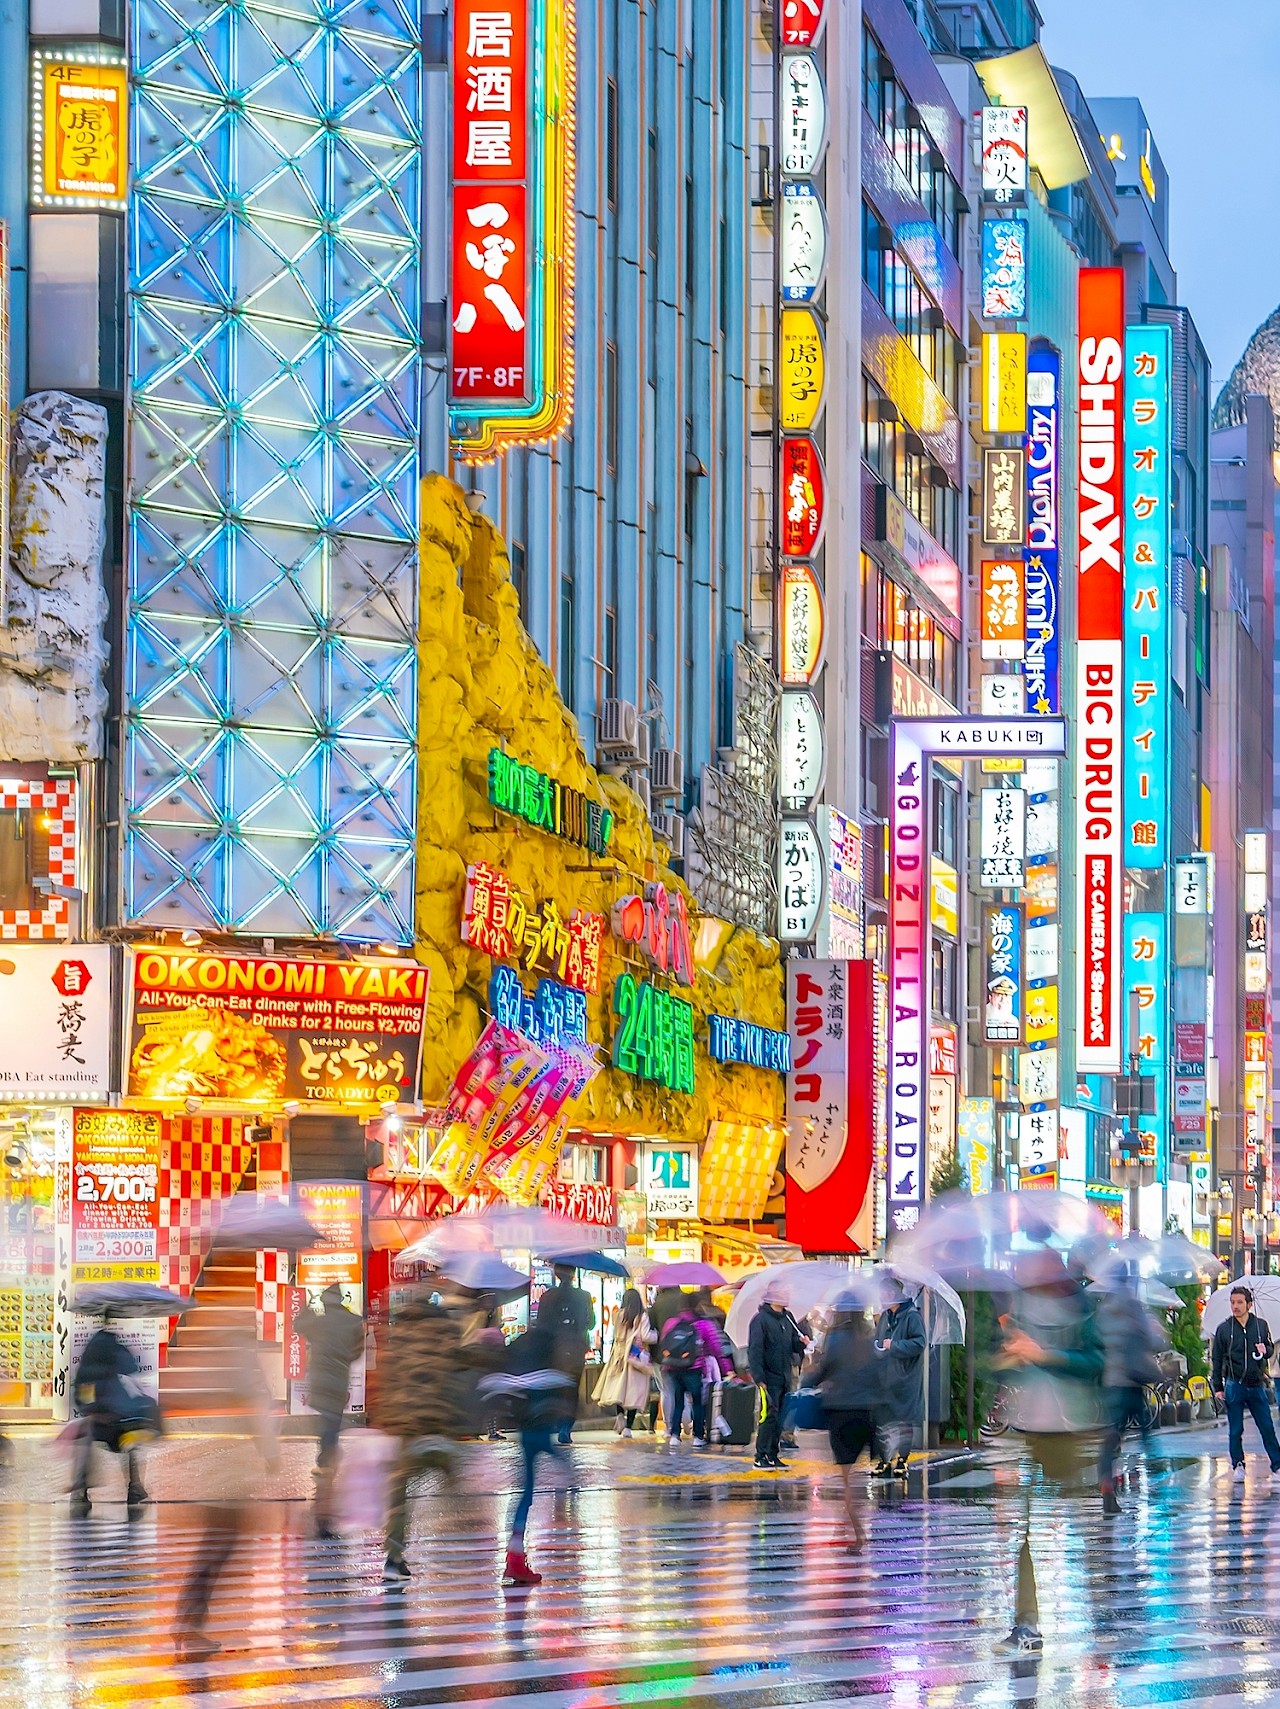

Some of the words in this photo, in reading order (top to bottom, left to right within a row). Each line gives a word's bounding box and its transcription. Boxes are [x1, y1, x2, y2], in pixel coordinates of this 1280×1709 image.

[786, 31, 810, 42] 7F
[50, 67, 82, 81] 4F
[465, 11, 513, 167] 居酒屋
[68, 108, 103, 167] 虎の子
[785, 154, 812, 170] 6F
[994, 189, 1012, 203] 8F
[453, 202, 525, 333] つぼ八
[789, 287, 808, 299] 5F
[787, 344, 818, 401] 虎の子
[786, 413, 805, 424] 4F
[1080, 336, 1122, 574] SHIDAX
[1086, 664, 1113, 725] BIC
[1086, 738, 1113, 840] DRUG
[787, 797, 807, 809] 1F
[785, 830, 809, 842] 新宿
[895, 795, 920, 1023] GODZILLA
[786, 917, 808, 931] B1
[990, 912, 1014, 975] 海の家
[63, 963, 83, 989] 旨
[139, 955, 324, 994] OKONOMI
[340, 965, 426, 998] YAKI
[140, 993, 252, 1010] All-You-Can-Eat
[255, 997, 300, 1012] dinner
[304, 1000, 331, 1014] with
[335, 1002, 421, 1020] Free-Flowing
[826, 964, 845, 1041] 大衆酒場
[56, 1001, 86, 1065] 蕎麦
[252, 1012, 298, 1029] Drinks
[301, 1014, 321, 1029] for
[324, 1016, 333, 1030] 2
[335, 1016, 375, 1031] hours
[378, 1019, 421, 1035] ¥2,700
[714, 1015, 737, 1057] THE
[794, 972, 824, 1103] トラノコ
[299, 1038, 405, 1081] とらぢゅう
[1176, 1060, 1204, 1075] Cafe
[25, 1072, 45, 1082] Eat
[48, 1071, 99, 1084] standing
[306, 1086, 374, 1100] TORADYU
[379, 1088, 396, 1100] 2F
[894, 1052, 918, 1158] ROAD
[76, 1113, 158, 1132] お好み焼き
[75, 1134, 130, 1146] OKONOMI
[131, 1133, 159, 1146] YAKI
[1030, 1115, 1046, 1161] 牛かつ
[77, 1176, 156, 1203] 2,700円
[299, 1186, 361, 1198] OKONOMI
[315, 1199, 347, 1210] YAKI
[649, 1199, 695, 1213] 虎の子
[95, 1240, 154, 1258] 2,300円
[717, 1254, 767, 1268] トラノコ
